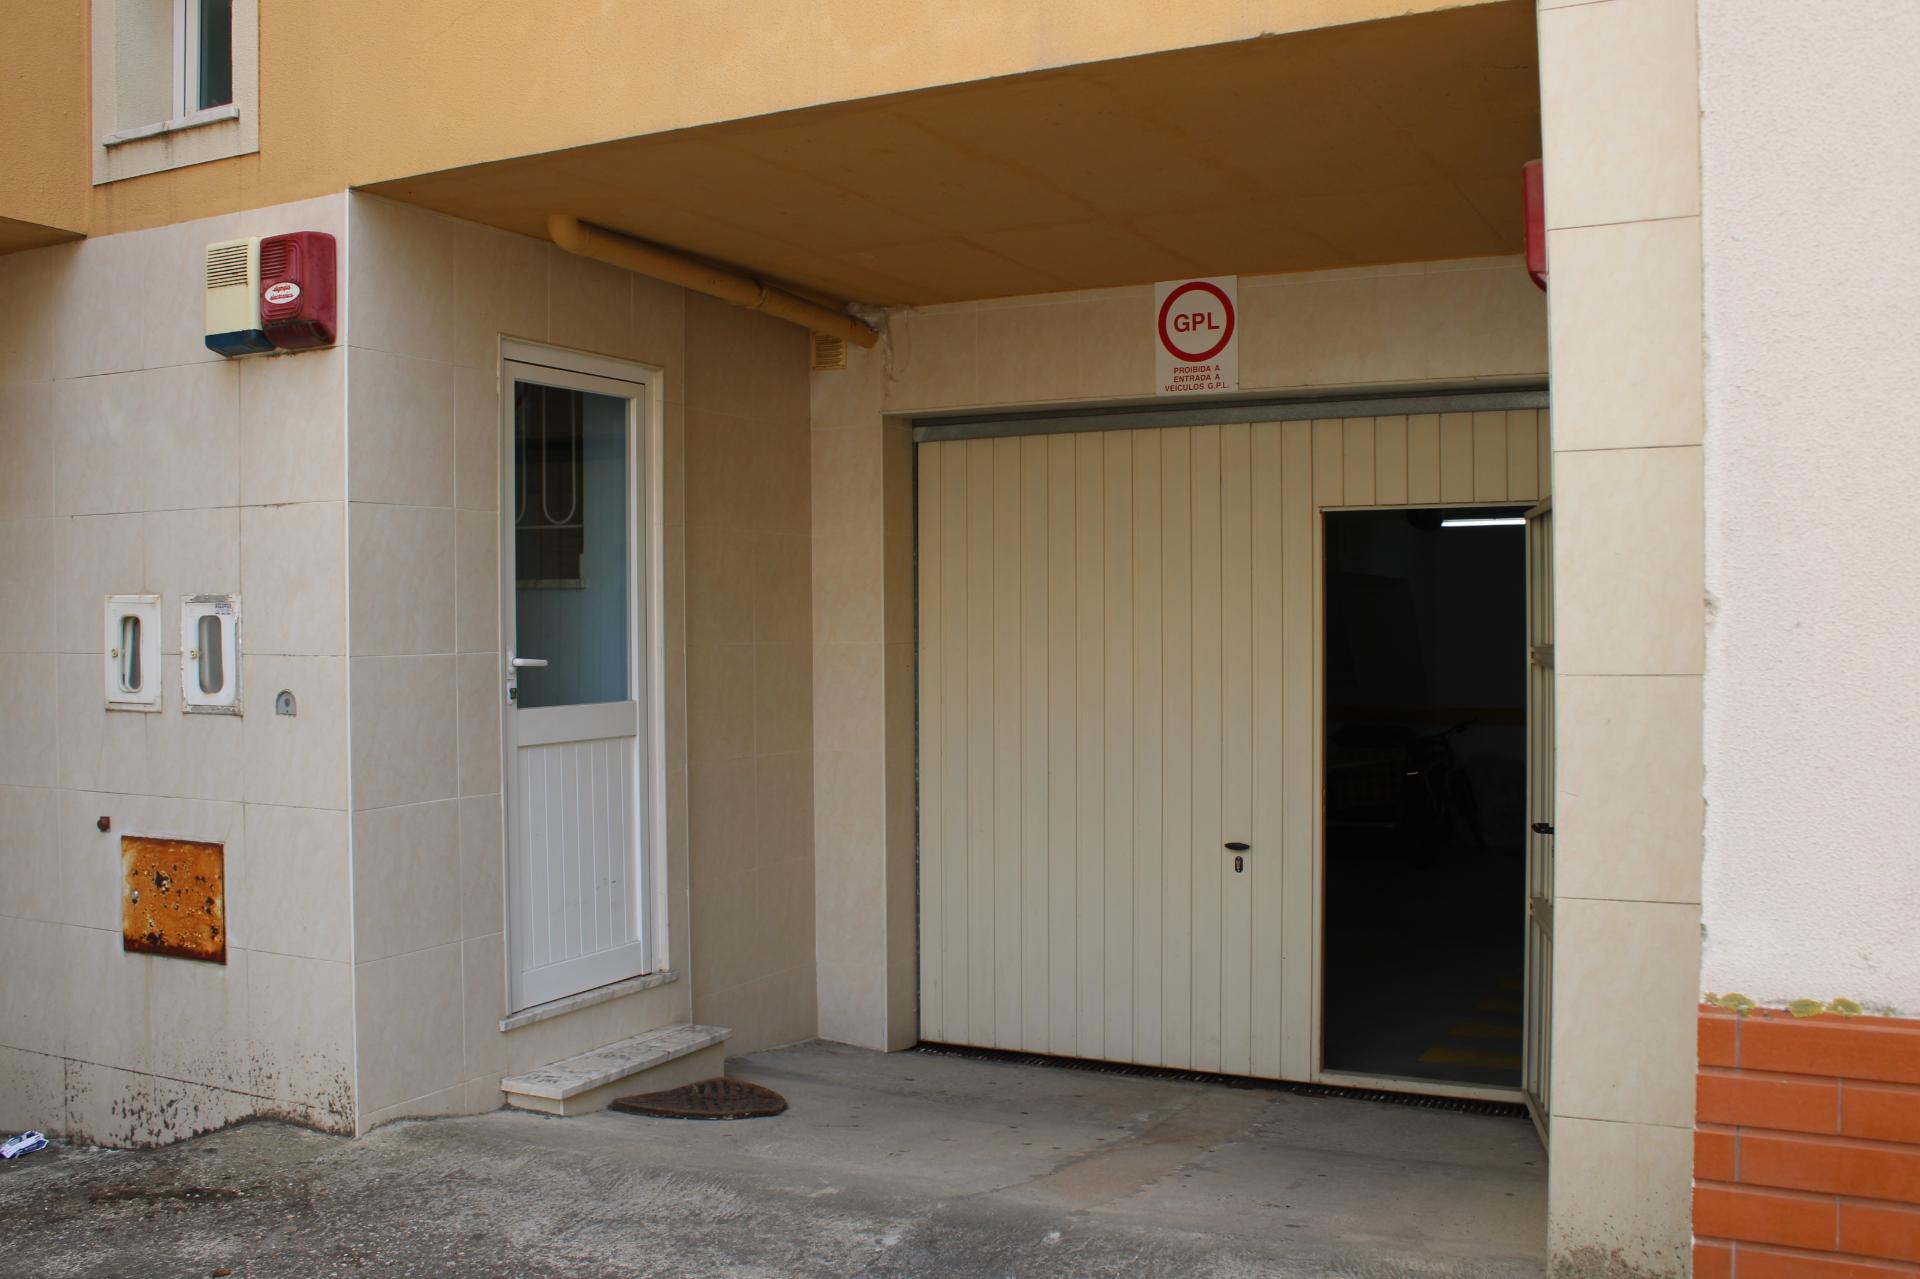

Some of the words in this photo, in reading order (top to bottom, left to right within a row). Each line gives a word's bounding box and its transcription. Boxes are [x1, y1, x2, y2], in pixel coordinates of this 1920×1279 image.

[1174, 312, 1219, 332] GPL
[1174, 366, 1211, 374] PROIBIDA
[1174, 374, 1211, 383] ENTRADA
